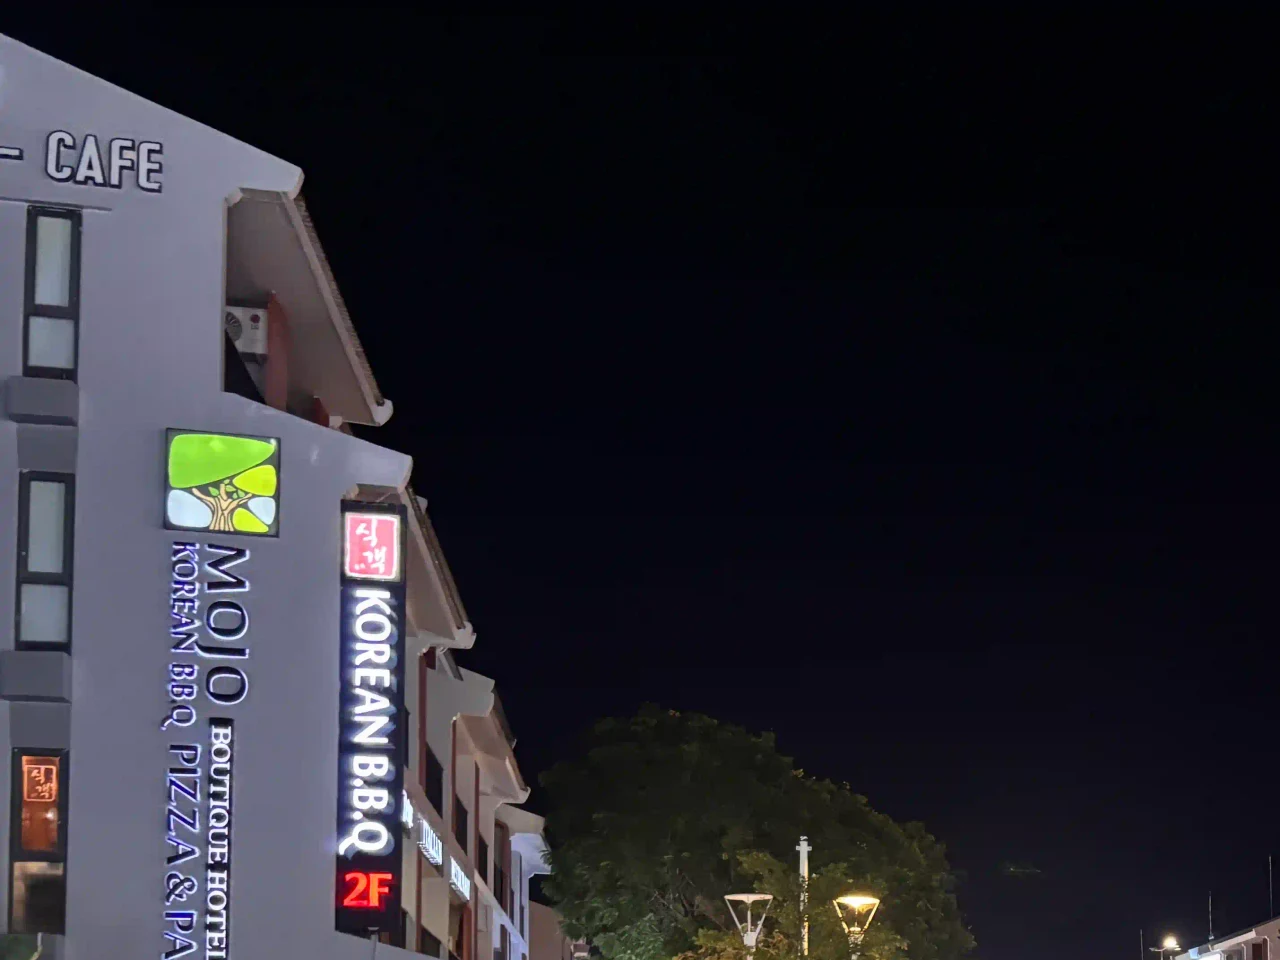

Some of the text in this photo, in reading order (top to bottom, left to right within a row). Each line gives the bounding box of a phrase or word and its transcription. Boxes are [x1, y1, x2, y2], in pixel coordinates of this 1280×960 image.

[46, 130, 163, 193] CAFE
[169, 541, 200, 653] KOREAN
[194, 543, 250, 706] MOJO
[353, 588, 394, 744] KOREAN
[166, 744, 202, 864] PIZZA
[207, 726, 232, 864] BOUTIQUE
[164, 871, 198, 906] &
[343, 872, 394, 908] 2F
